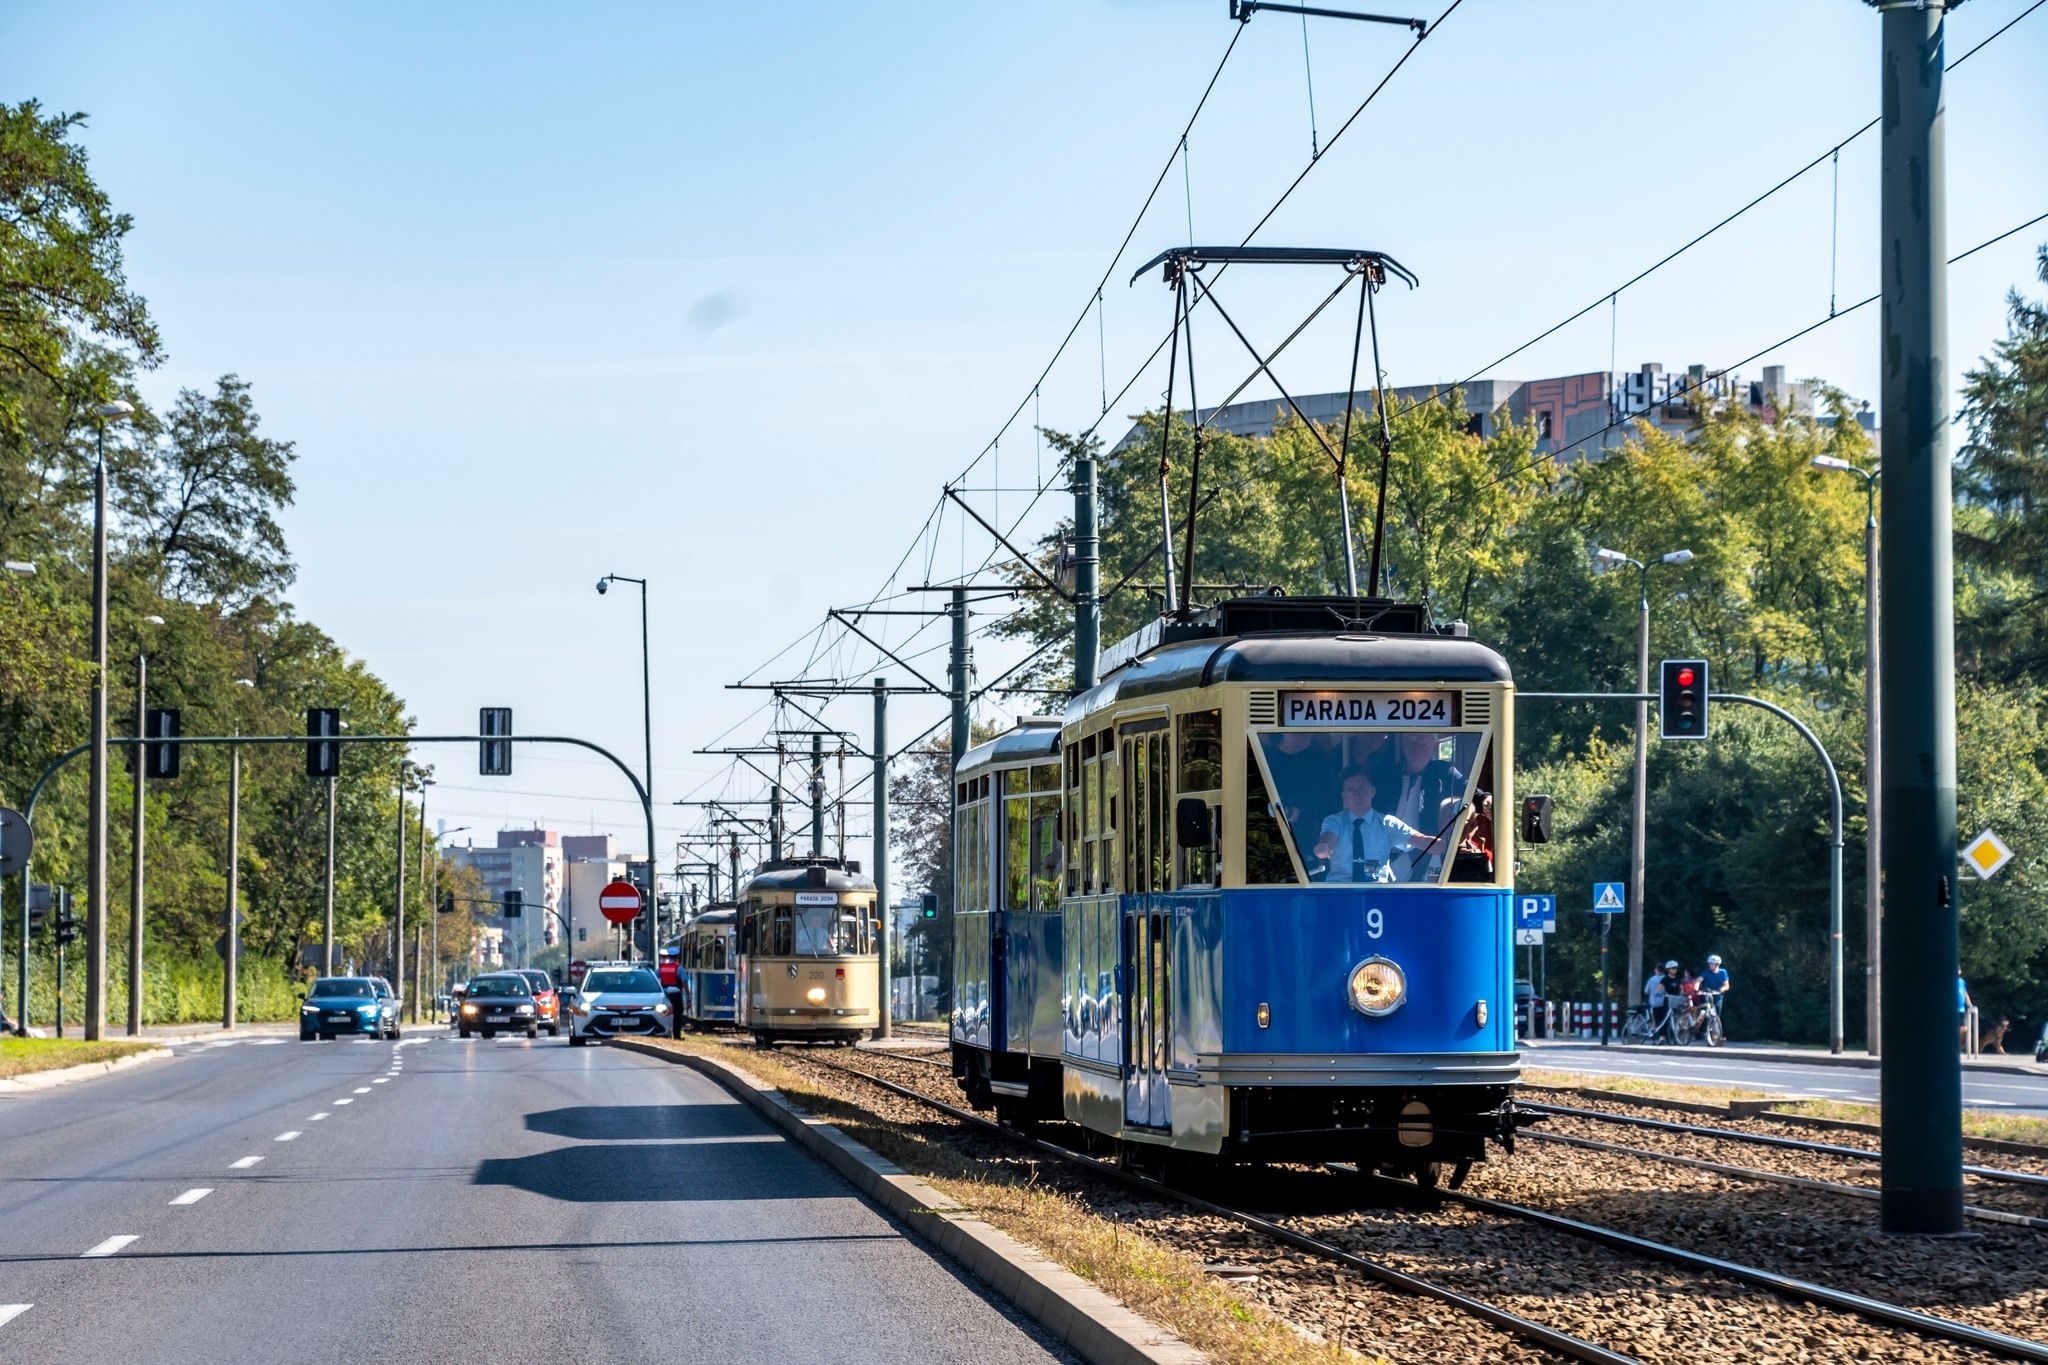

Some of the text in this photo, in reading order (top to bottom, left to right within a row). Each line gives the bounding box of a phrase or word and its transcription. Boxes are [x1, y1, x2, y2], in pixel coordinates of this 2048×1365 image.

[1290, 699, 1446, 721] PARADA 2024
[1522, 898, 1538, 920] P
[1366, 908, 1383, 939] 9
[808, 970, 825, 981] 220
